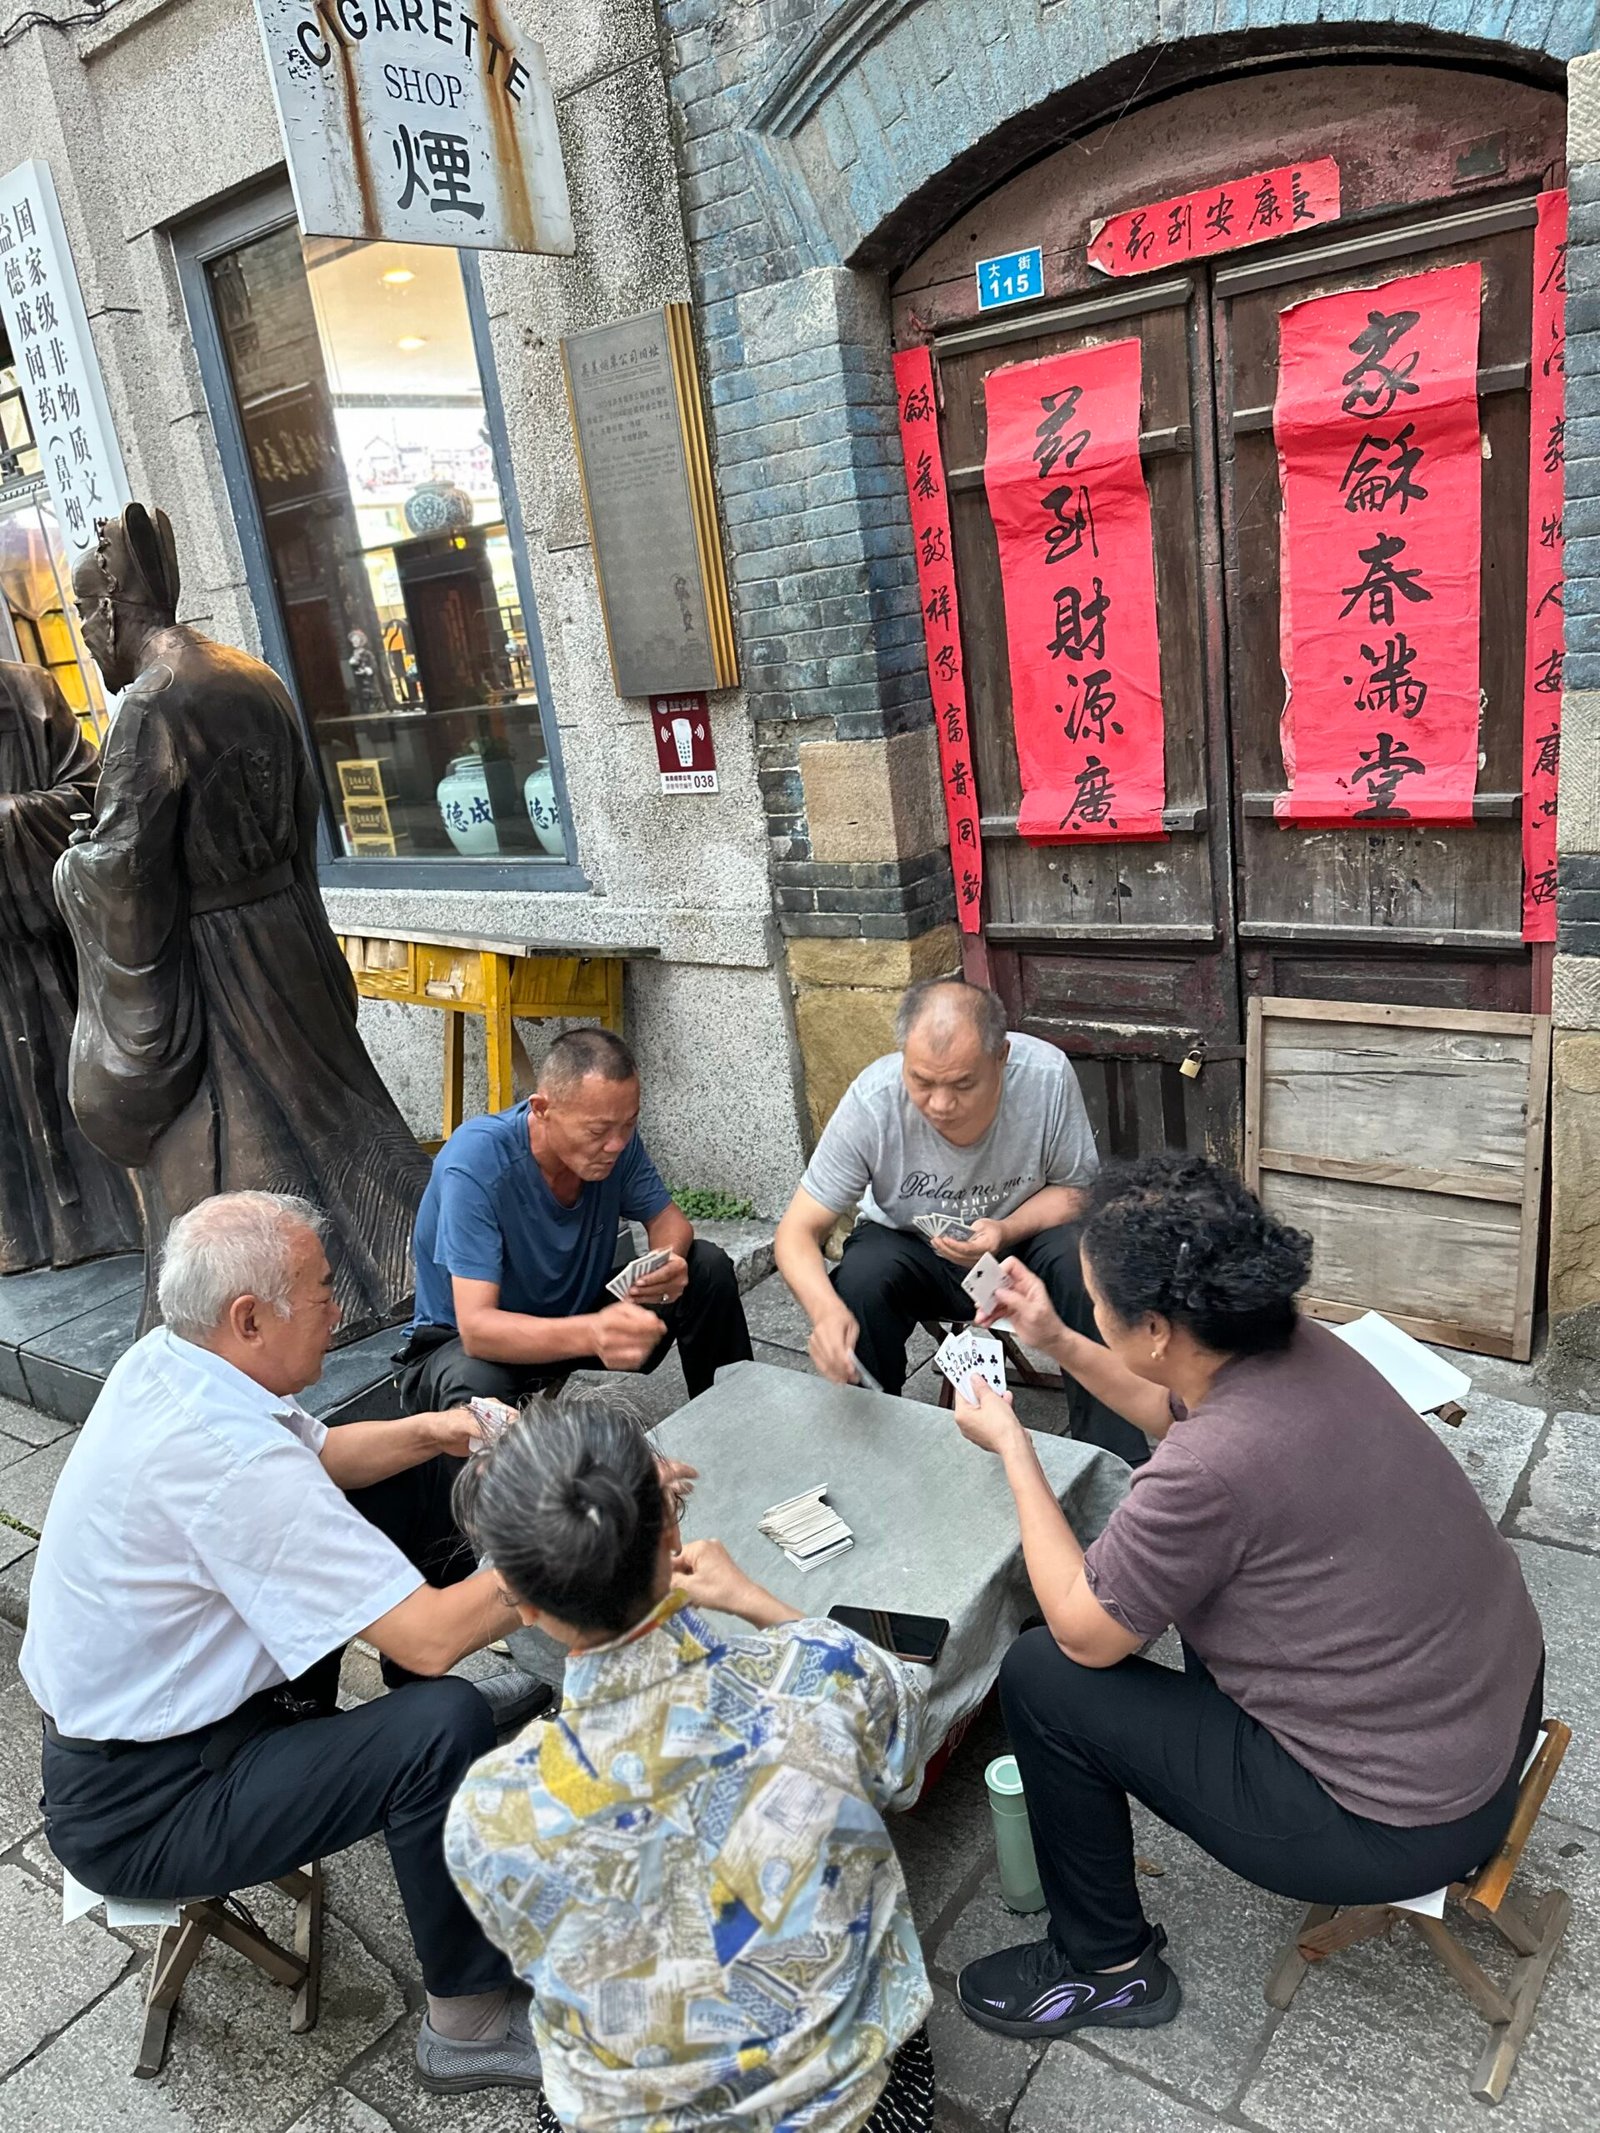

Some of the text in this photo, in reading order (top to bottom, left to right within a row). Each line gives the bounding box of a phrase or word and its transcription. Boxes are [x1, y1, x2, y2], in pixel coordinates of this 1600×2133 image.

[383, 64, 462, 109] SHOP
[392, 123, 485, 221] 煙
[988, 255, 1031, 280] 大街
[990, 274, 1030, 299] 115
[694, 775, 715, 788] 038
[899, 1171, 966, 1200] Relax
